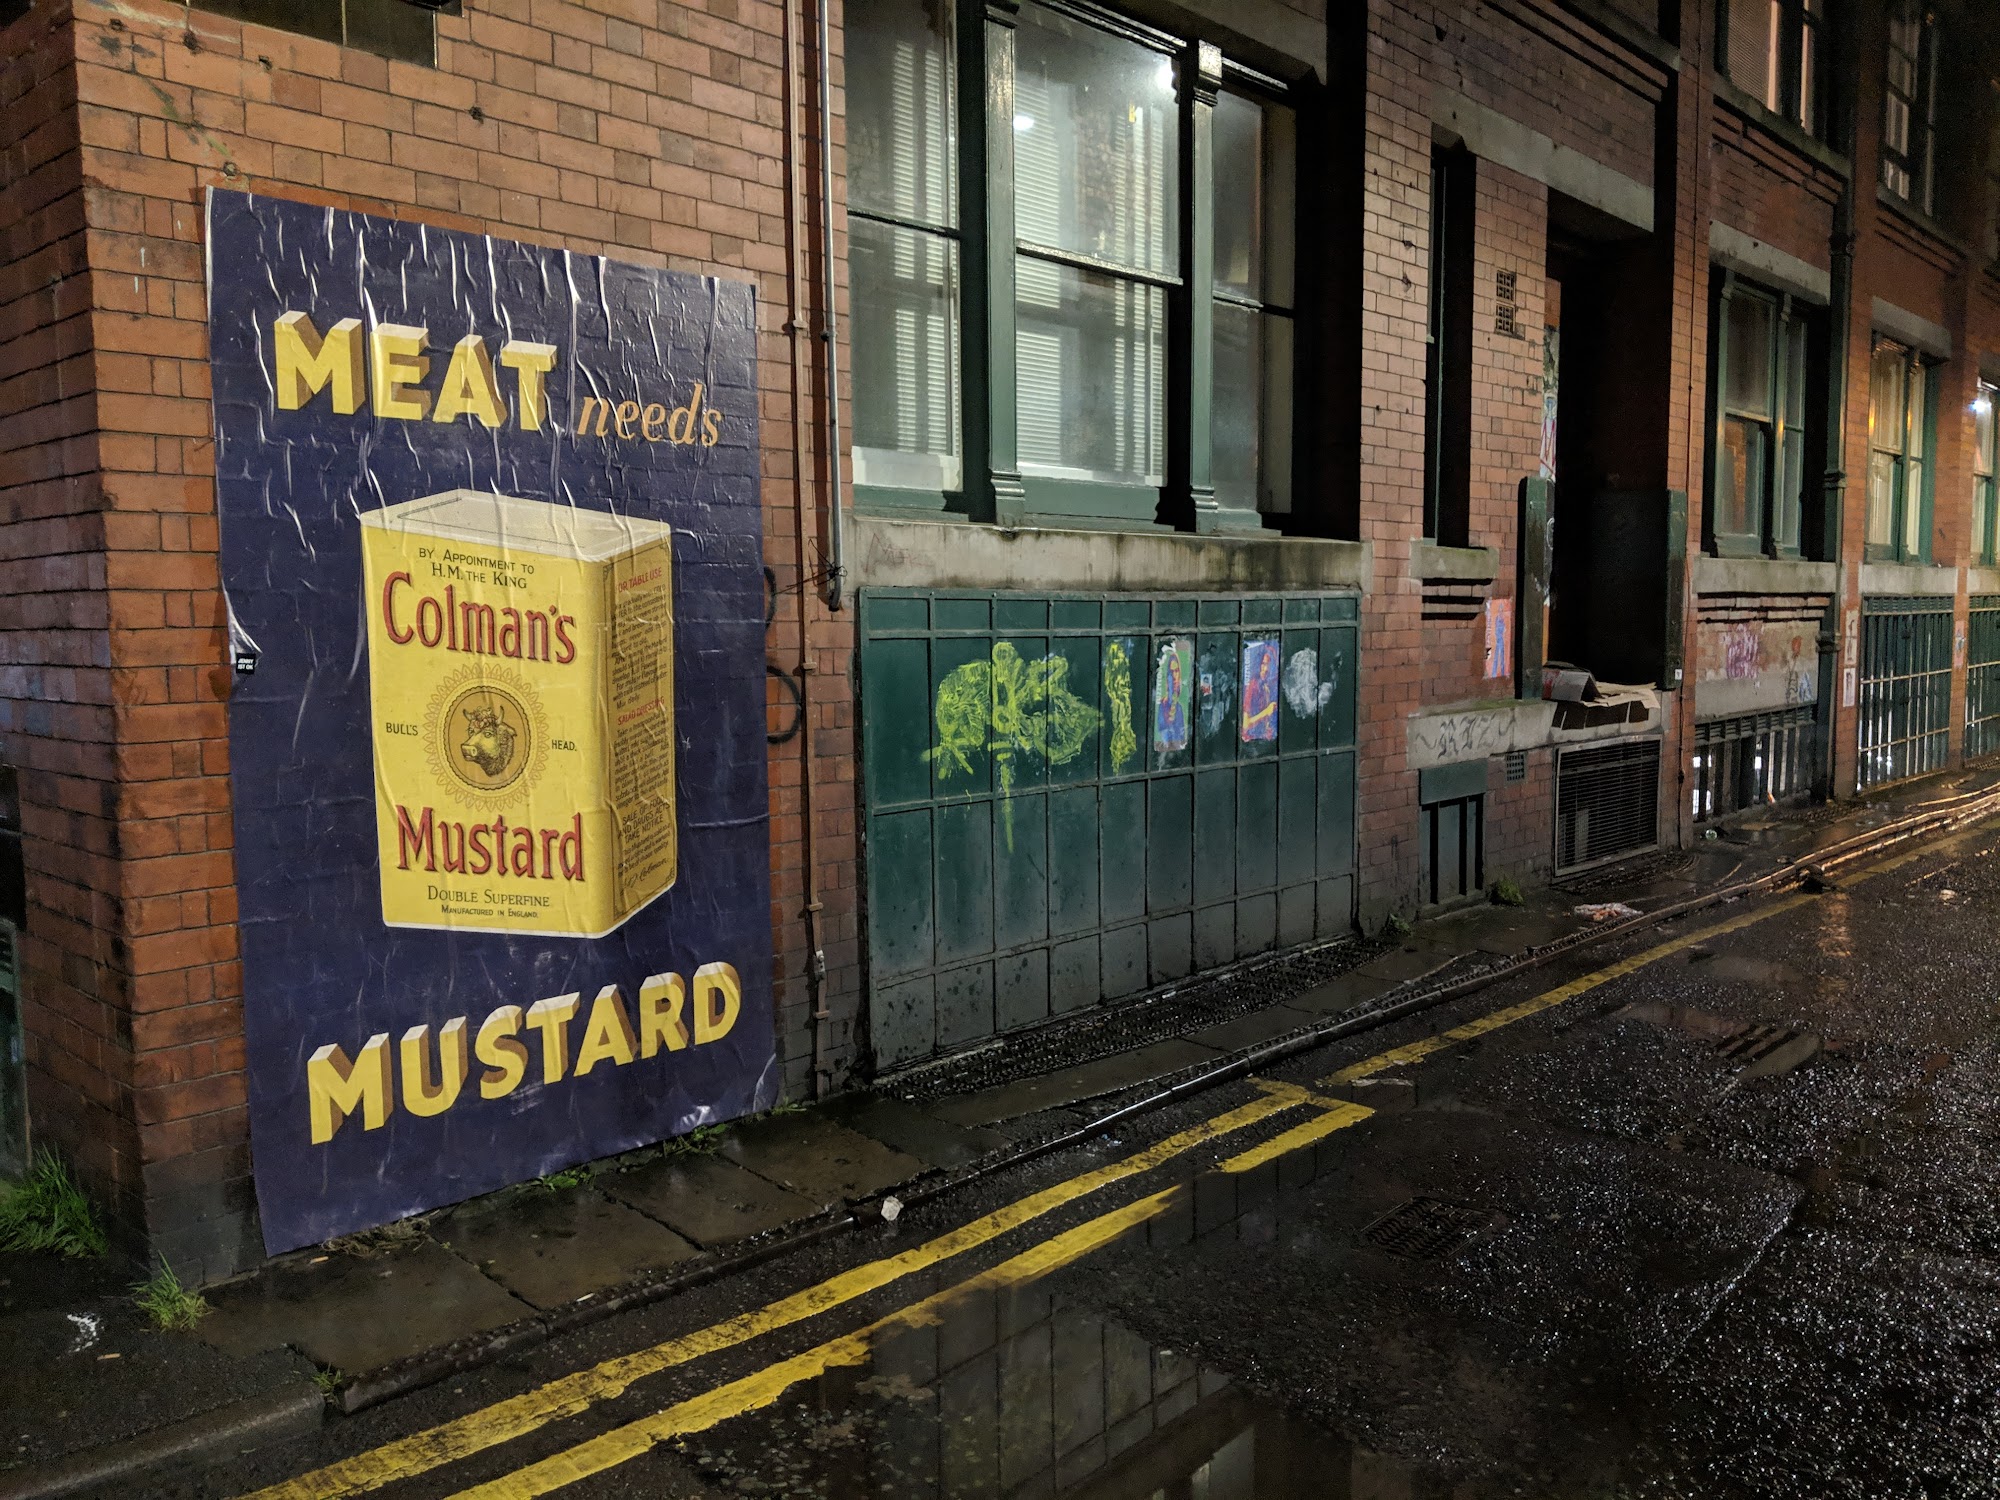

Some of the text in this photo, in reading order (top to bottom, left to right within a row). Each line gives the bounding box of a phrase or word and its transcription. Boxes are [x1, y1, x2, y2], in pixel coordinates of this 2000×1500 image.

[274, 310, 723, 447] MEAT needs
[418, 547, 535, 575] BY APPOINTMENT TO
[431, 562, 528, 589] H.M. THE KING
[629, 572, 649, 589] TABLE
[650, 566, 662, 581] USE
[383, 570, 577, 665] Colman's
[385, 722, 577, 752] BULL'S HEAD.
[623, 810, 638, 826] SALE
[640, 803, 648, 816] OF
[633, 811, 654, 830] DRUGS
[396, 804, 586, 882] Mustard
[624, 814, 664, 844] TAKE NOTICE
[428, 885, 550, 907] DOUBLE SUPERFINE
[441, 904, 494, 916] MANUFACTURED
[508, 908, 539, 918] ENGLAND.
[306, 961, 742, 1145] MUSTARD
